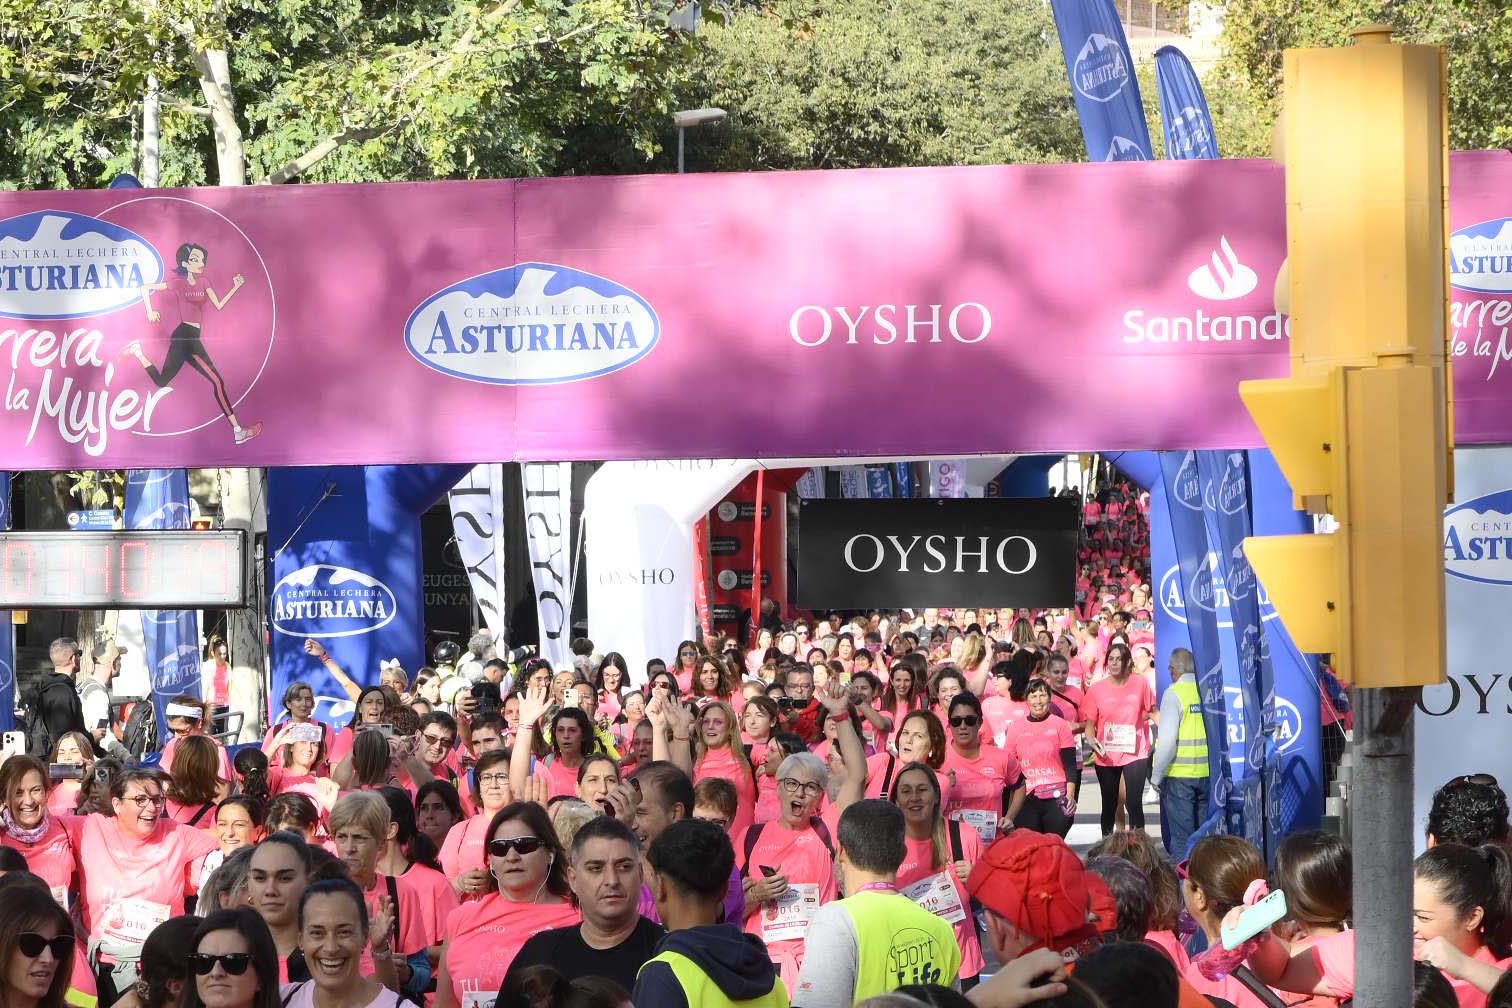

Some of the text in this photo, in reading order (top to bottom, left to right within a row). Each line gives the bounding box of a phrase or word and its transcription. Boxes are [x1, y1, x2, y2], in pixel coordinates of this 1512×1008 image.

[66, 247, 139, 260] LECHERA
[463, 303, 632, 319] CENTRAL LECHERA
[788, 302, 992, 347] OYSHO
[1122, 309, 1290, 344] Santand
[424, 309, 639, 356] ASTURIANA
[1473, 328, 1491, 357] la
[5, 371, 31, 411] la
[24, 363, 175, 457] Mujer
[843, 533, 1038, 575] OYSHO
[274, 593, 388, 622] ASTURIANA
[287, 588, 383, 598] CENTRAL LECHERA
[889, 938, 935, 973] Sport
